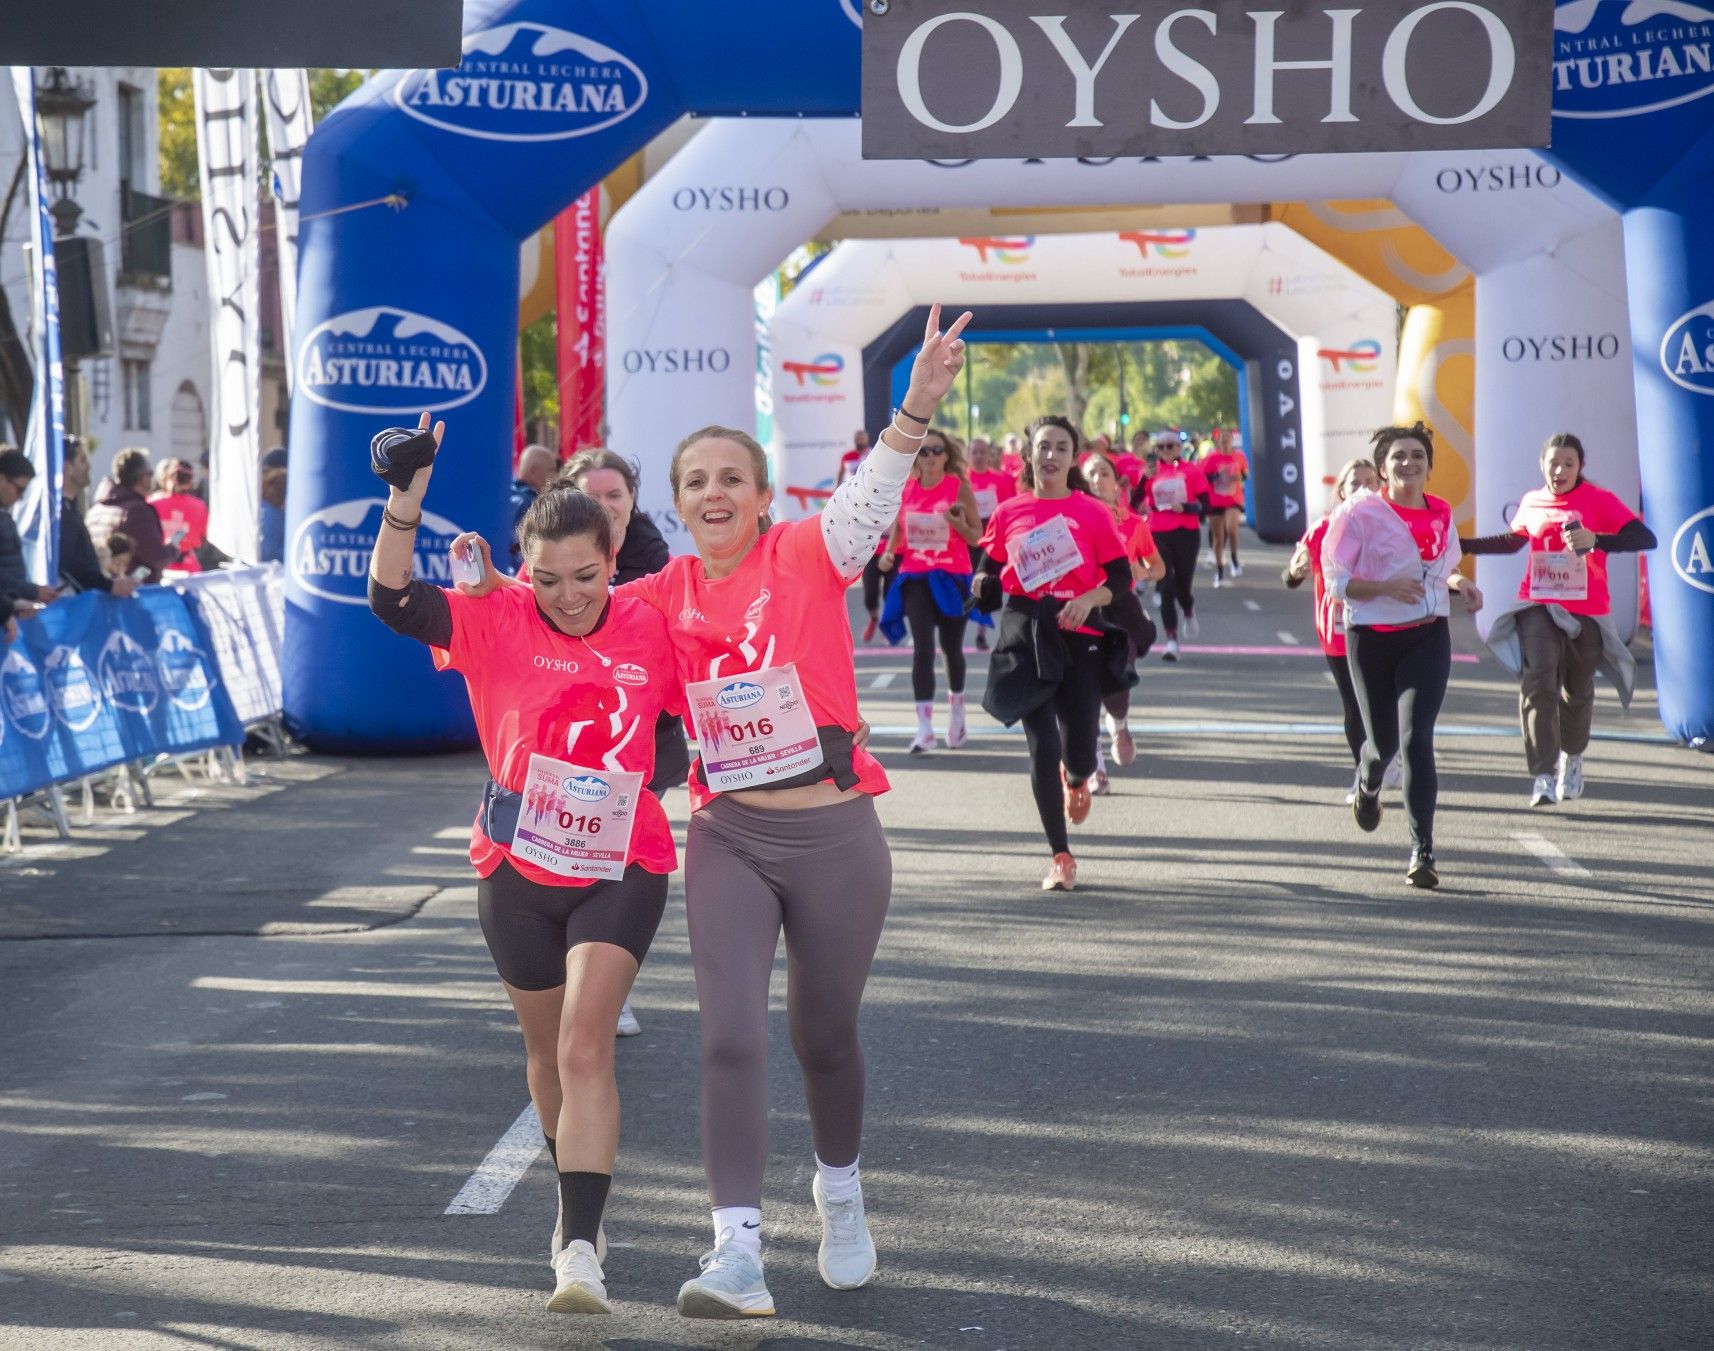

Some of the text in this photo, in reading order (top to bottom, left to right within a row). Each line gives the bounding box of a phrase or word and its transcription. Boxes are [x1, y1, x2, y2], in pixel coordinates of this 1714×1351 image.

[1560, 25, 1711, 54] NTRAL LECHER
[538, 63, 623, 80] LECHERA
[897, 1, 1515, 133] OYSHO
[1552, 43, 1714, 91] TURIAN
[408, 68, 627, 113] ASTURIANA
[1436, 163, 1561, 193] OYSHO
[673, 186, 789, 211] OYSHO
[328, 342, 469, 359] CENTRAL LECHERA
[1502, 331, 1619, 362] OYSHO
[306, 345, 473, 391] ASTURIANA
[624, 348, 730, 374] OYSHO
[1276, 359, 1300, 521] VOLVO
[320, 534, 374, 544] CENTRA
[1033, 545, 1055, 561] 016
[533, 655, 579, 674] OYSHO
[721, 690, 762, 705] ASTURIANA
[730, 718, 774, 742] 016
[720, 760, 741, 770] CARRERA
[757, 753, 776, 762] MUJER
[780, 745, 803, 757] SEVILLA
[749, 745, 765, 754] 689
[775, 757, 811, 774] Santander
[537, 773, 559, 787] SUMA
[720, 771, 753, 784] OYSHO
[566, 781, 607, 797] ASTURIANA
[558, 812, 601, 834] 016
[531, 836, 553, 850] CARRERA
[564, 838, 586, 848] 3886
[525, 846, 558, 865] OYSHO
[580, 864, 612, 873] Santander
